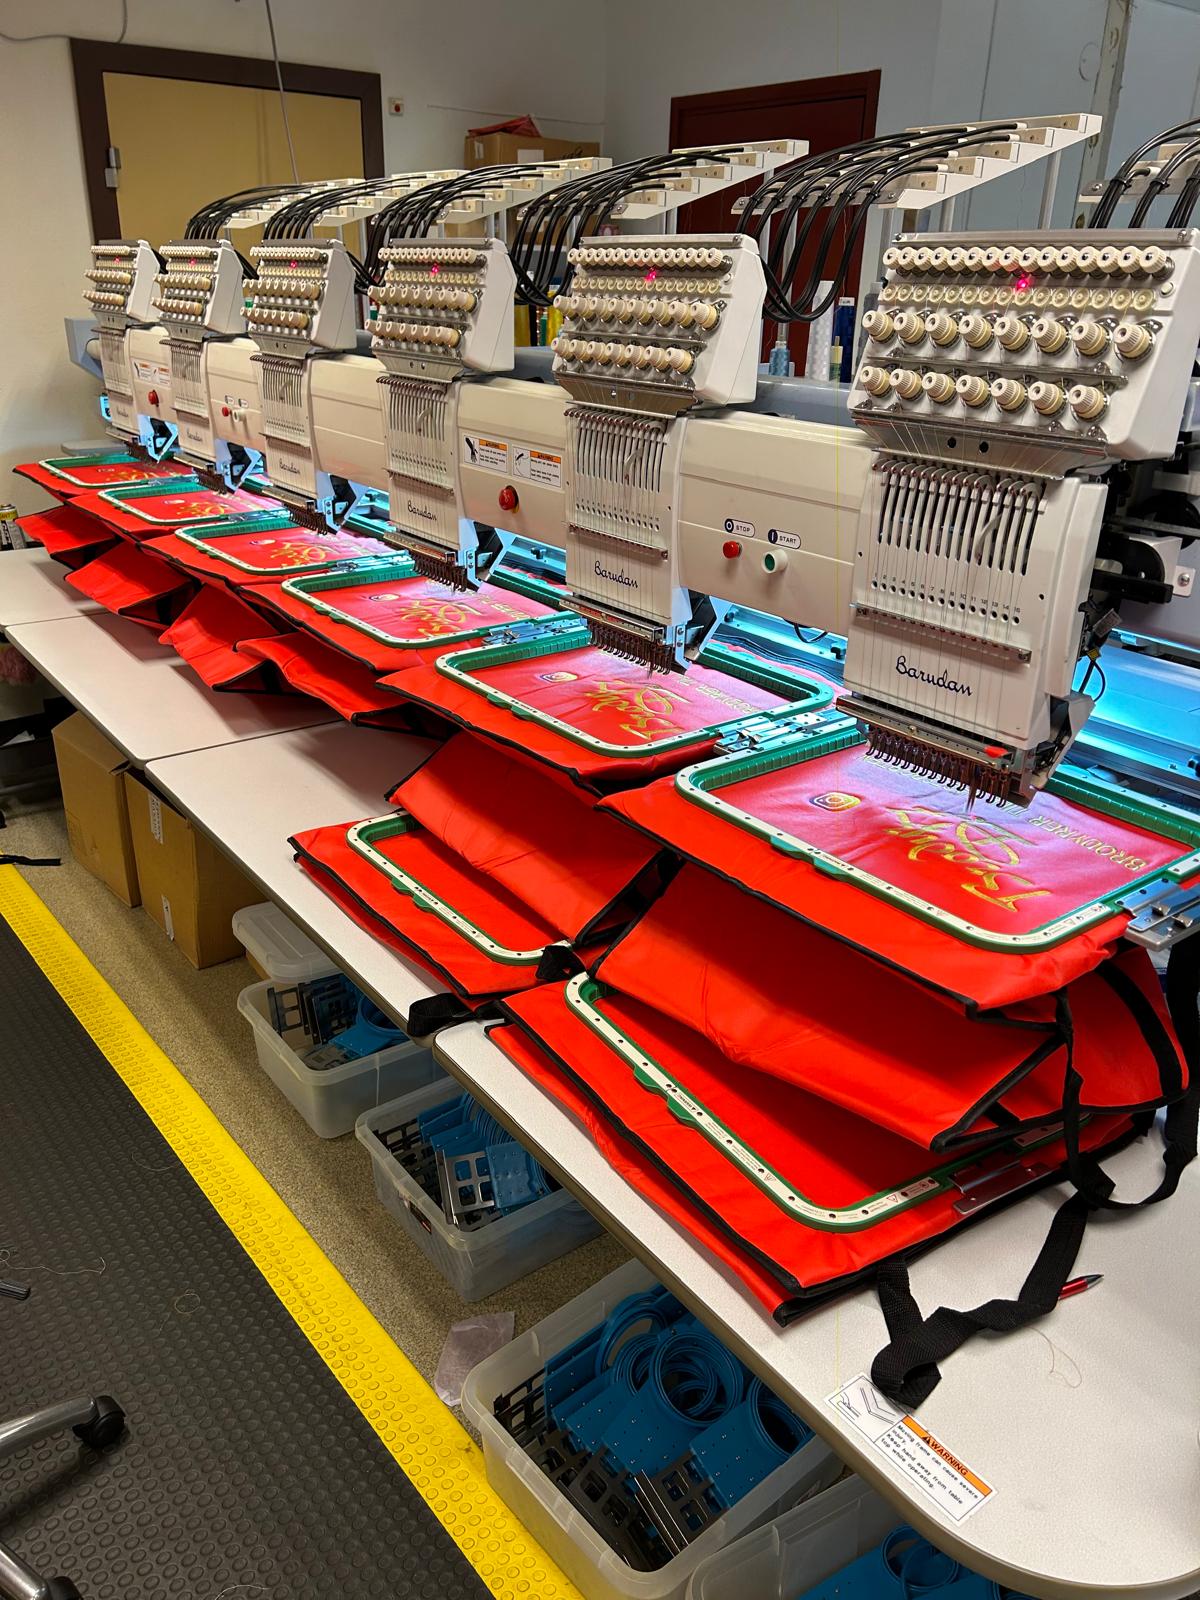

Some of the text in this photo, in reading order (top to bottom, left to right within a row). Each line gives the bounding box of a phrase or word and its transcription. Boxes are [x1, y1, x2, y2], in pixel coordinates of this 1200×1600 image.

[408, 500, 437, 521] Barudan
[779, 535, 797, 544] START
[594, 560, 638, 588] Barudan
[895, 655, 973, 697] Barudan
[1028, 815, 1147, 871] BRODYRER
[881, 1438, 891, 1449] top
[892, 1448, 906, 1463] while
[931, 1441, 969, 1476] WARNING
[886, 1434, 963, 1505] Keep hand away from table
[915, 1441, 931, 1457] frame
[931, 1456, 942, 1467] can
[942, 1466, 958, 1481] cause
[959, 1481, 979, 1499] severe
